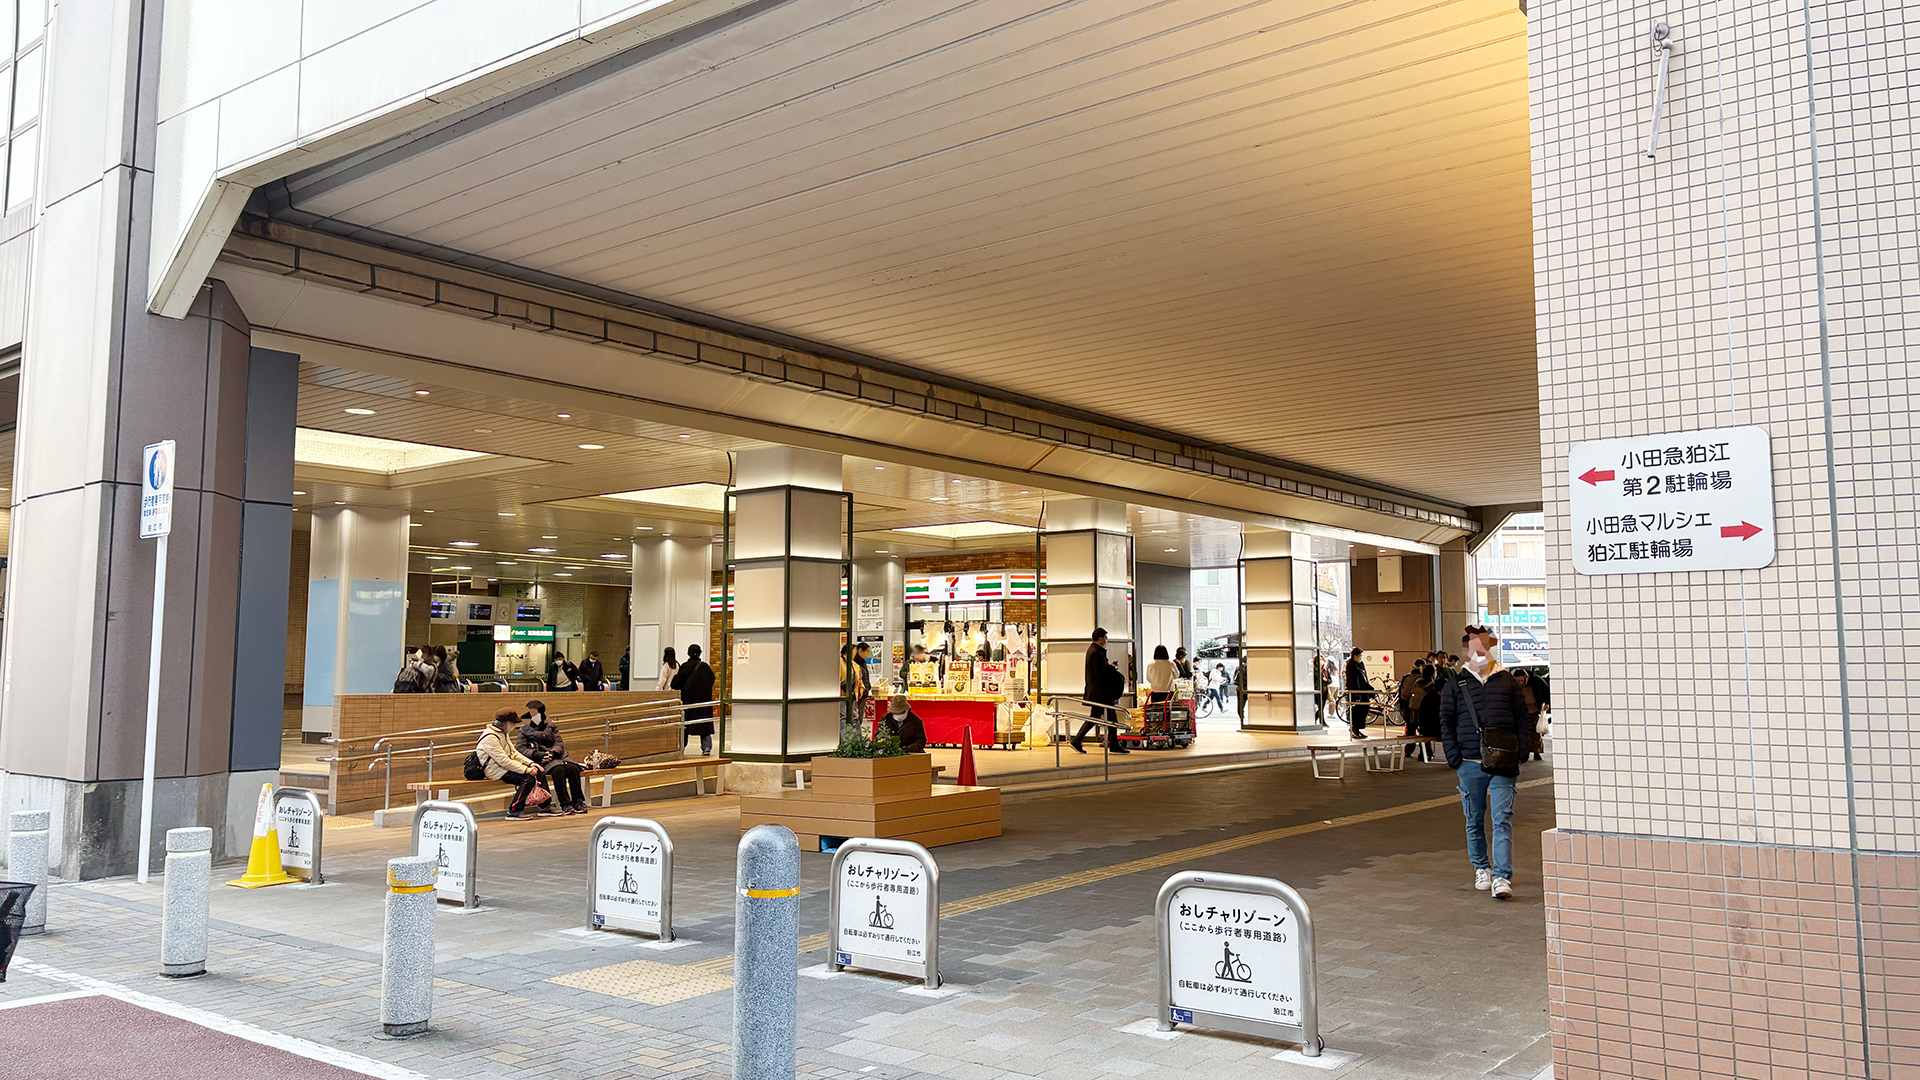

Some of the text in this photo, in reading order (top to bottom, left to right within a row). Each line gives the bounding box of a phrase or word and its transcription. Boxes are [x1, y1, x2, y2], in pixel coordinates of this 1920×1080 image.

[1621, 442, 1731, 469] 小田急狛江
[1622, 470, 1732, 497] 第2駐輪場
[1588, 538, 1694, 563] 狛江駐輪場
[861, 598, 880, 608] 北口
[279, 806, 312, 816] おしチャリゾーン
[423, 820, 465, 832] おしチャリゾーン
[602, 839, 658, 854] おしチャリゾーン
[848, 864, 919, 882] おしチャリゾーン
[1179, 903, 1286, 927] おしチャリゾーン
[1179, 921, 1287, 943] （ここから歩行者専用道路）
[1178, 979, 1293, 1003] 自転車は必ずおりて通行してください
[1273, 1007, 1294, 1017] 狛江市
